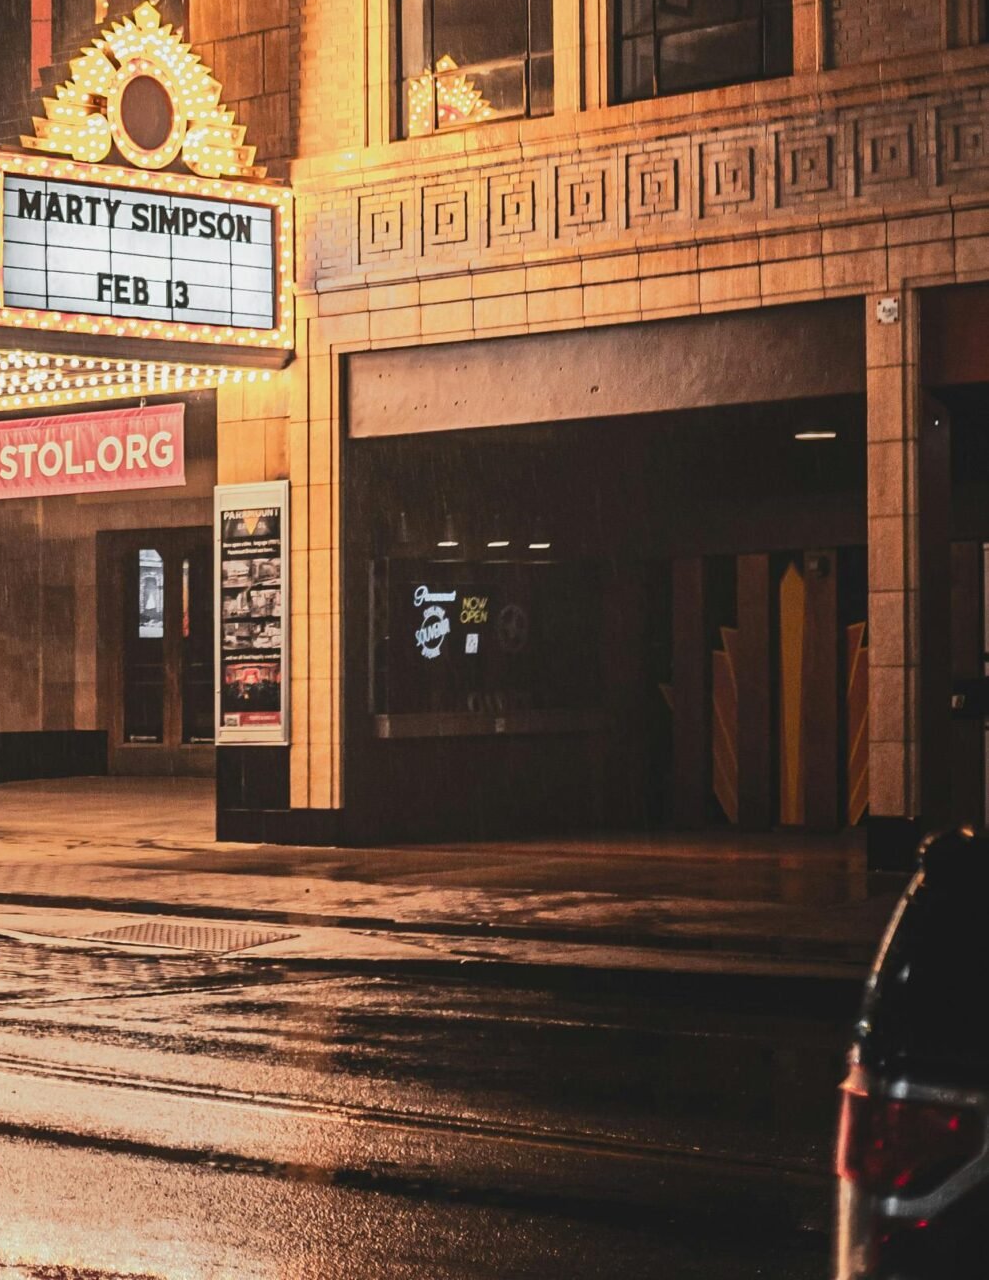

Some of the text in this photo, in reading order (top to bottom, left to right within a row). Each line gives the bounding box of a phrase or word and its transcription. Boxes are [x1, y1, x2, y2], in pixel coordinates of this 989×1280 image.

[18, 188, 252, 243] MARTY SIMPSON
[97, 272, 190, 308] FEB 13
[462, 596, 489, 610] NOW
[460, 610, 489, 623] OPEN
